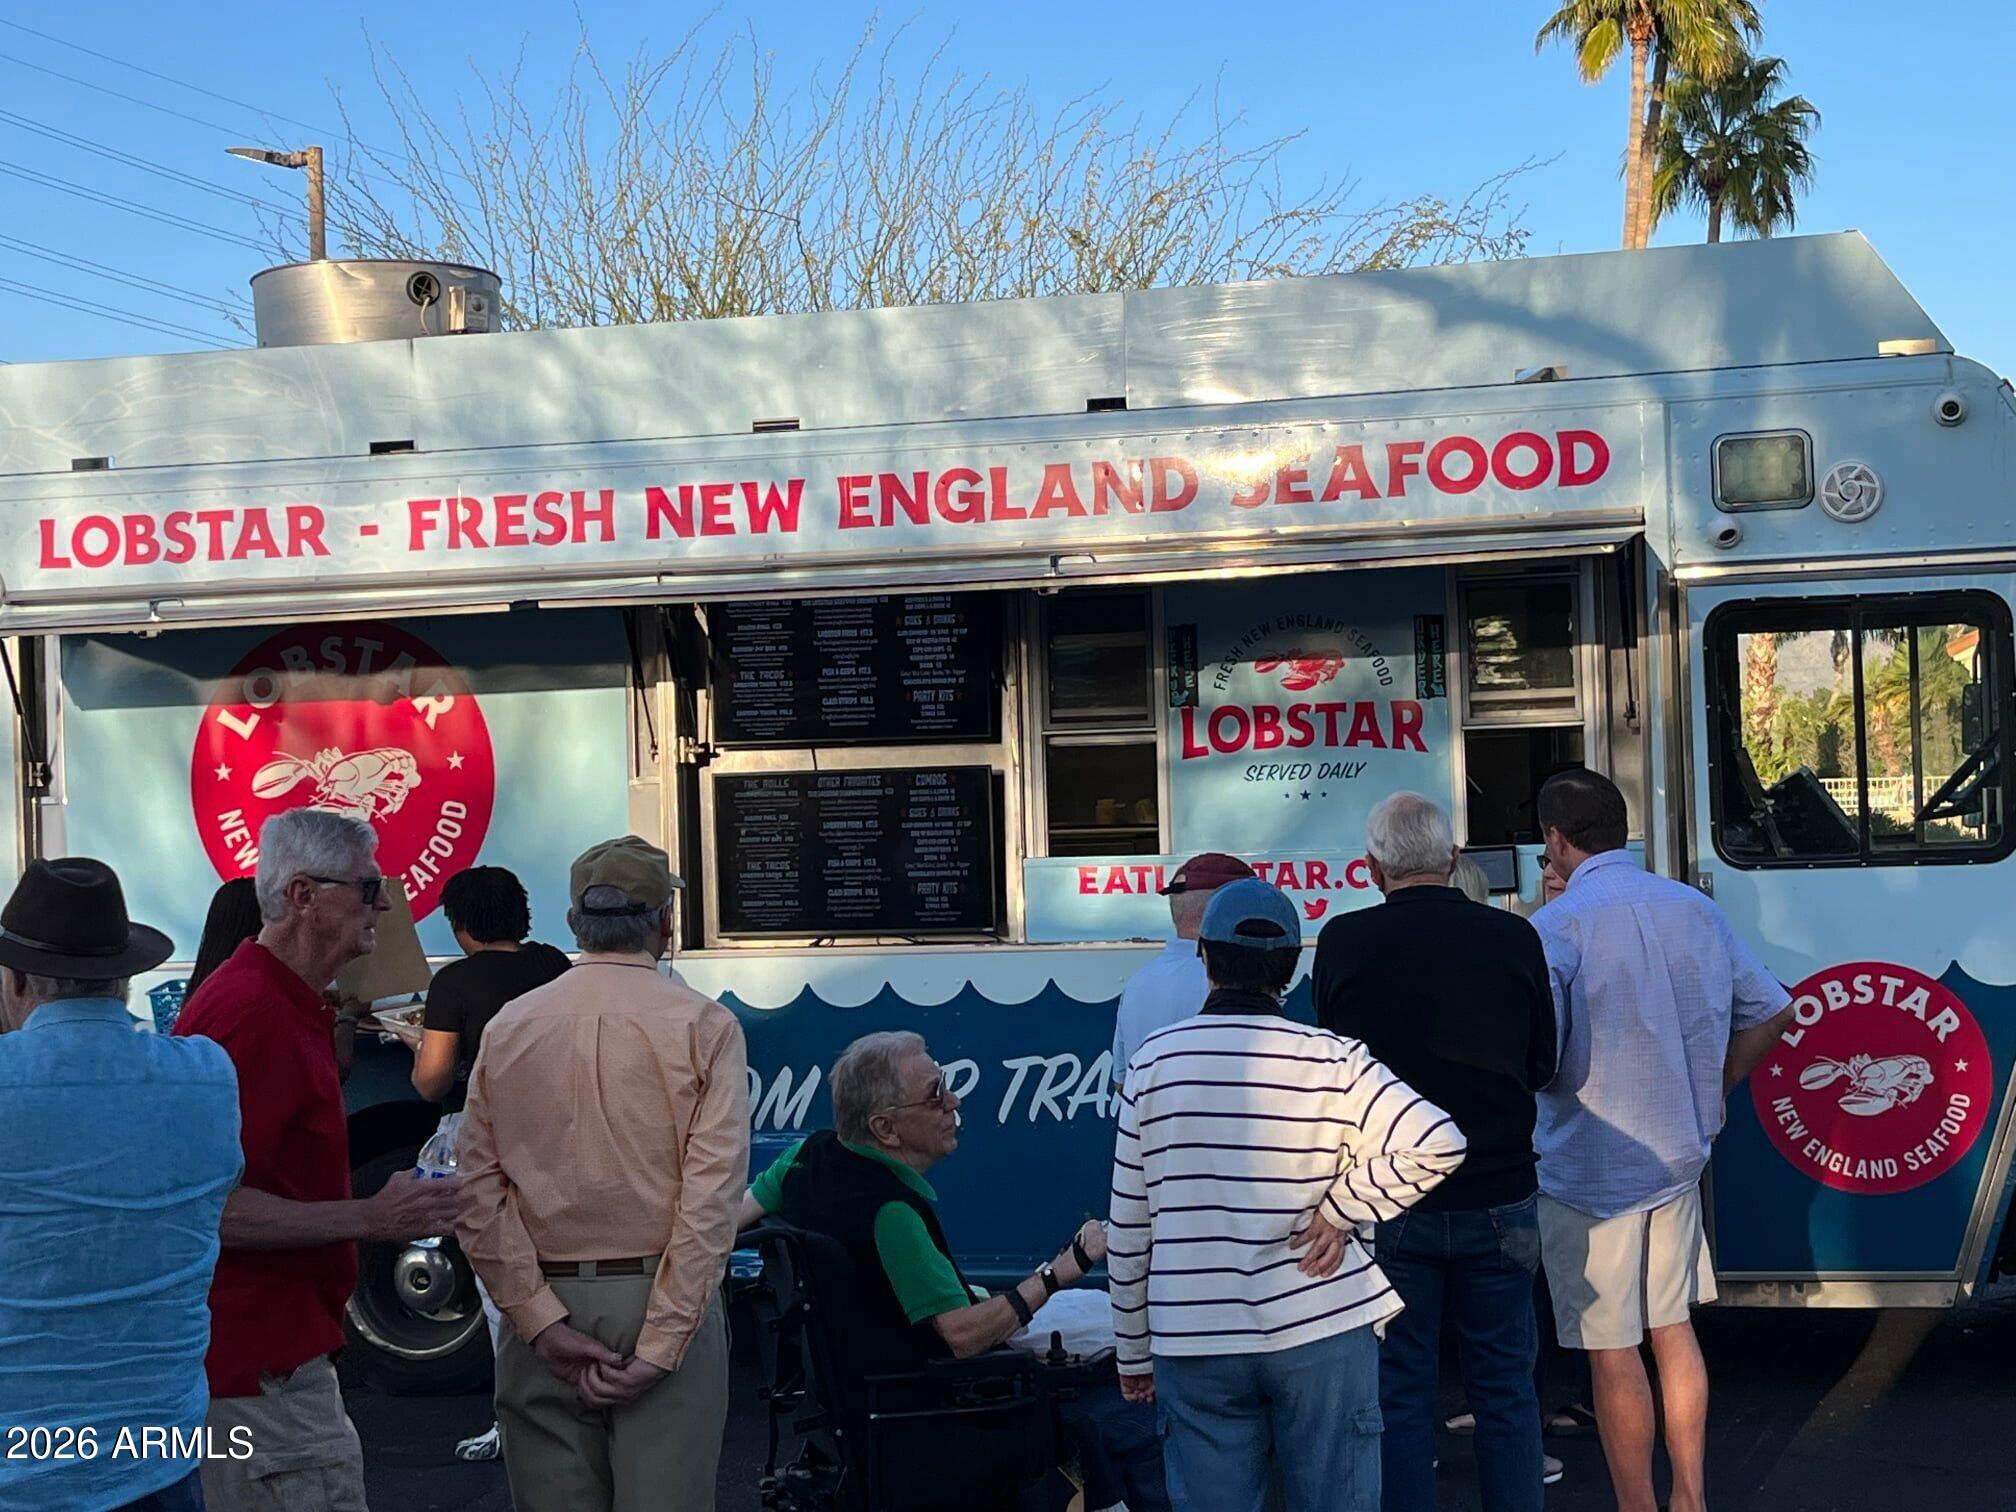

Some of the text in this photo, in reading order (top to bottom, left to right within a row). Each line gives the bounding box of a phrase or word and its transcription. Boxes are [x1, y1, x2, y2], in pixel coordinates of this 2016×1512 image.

[38, 503, 331, 571] LOBSTAR
[406, 488, 617, 552] FRESH
[645, 477, 805, 541] NEW
[835, 458, 1199, 530] ENGLAND
[1231, 429, 1611, 508] SEAFOOD
[216, 635, 455, 742] LOBSTAR
[1213, 613, 1394, 690] FRESH NEW ENGLAND SEAFOOD
[1430, 623, 1443, 684] HERE
[1180, 699, 1430, 760] LOBSTAR
[1244, 761, 1368, 782] SERVED DAILY
[217, 808, 260, 871] NEW
[402, 800, 467, 902] EAFOOD
[1780, 973, 1961, 1049] LOBSTAR
[998, 1050, 1123, 1124] TRA
[1772, 1092, 1971, 1180] NEW ENGLAND SEAFOOD
